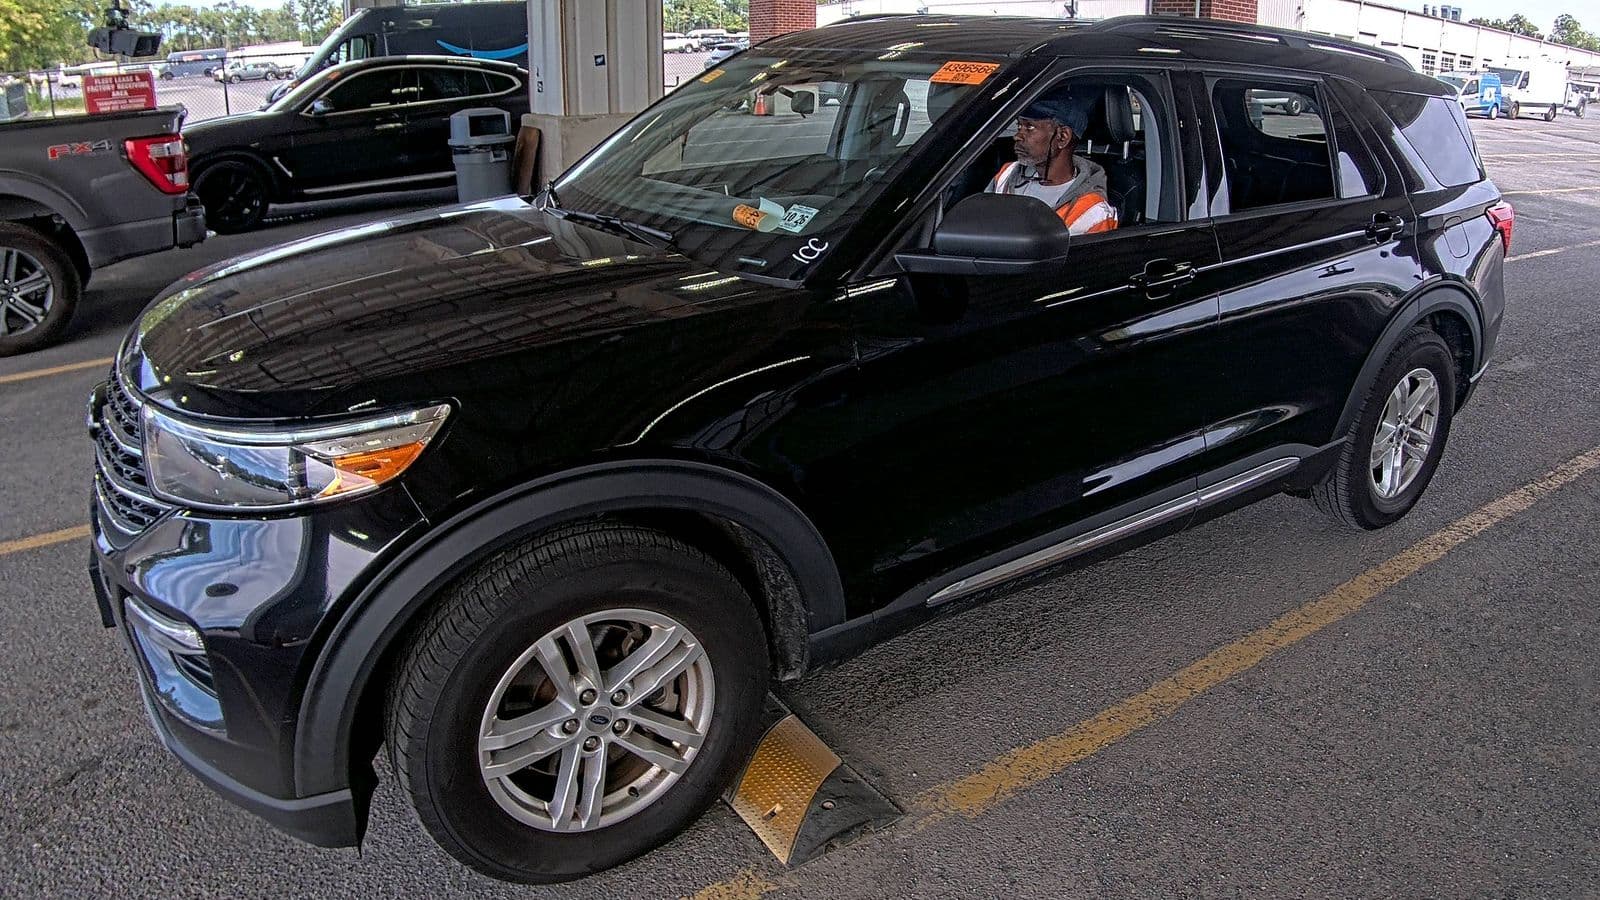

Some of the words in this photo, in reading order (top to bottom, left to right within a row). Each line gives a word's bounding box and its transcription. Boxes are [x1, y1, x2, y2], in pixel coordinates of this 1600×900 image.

[115, 75, 133, 83] LEASE
[87, 84, 115, 93] FACTORY
[48, 139, 112, 159] FX4
